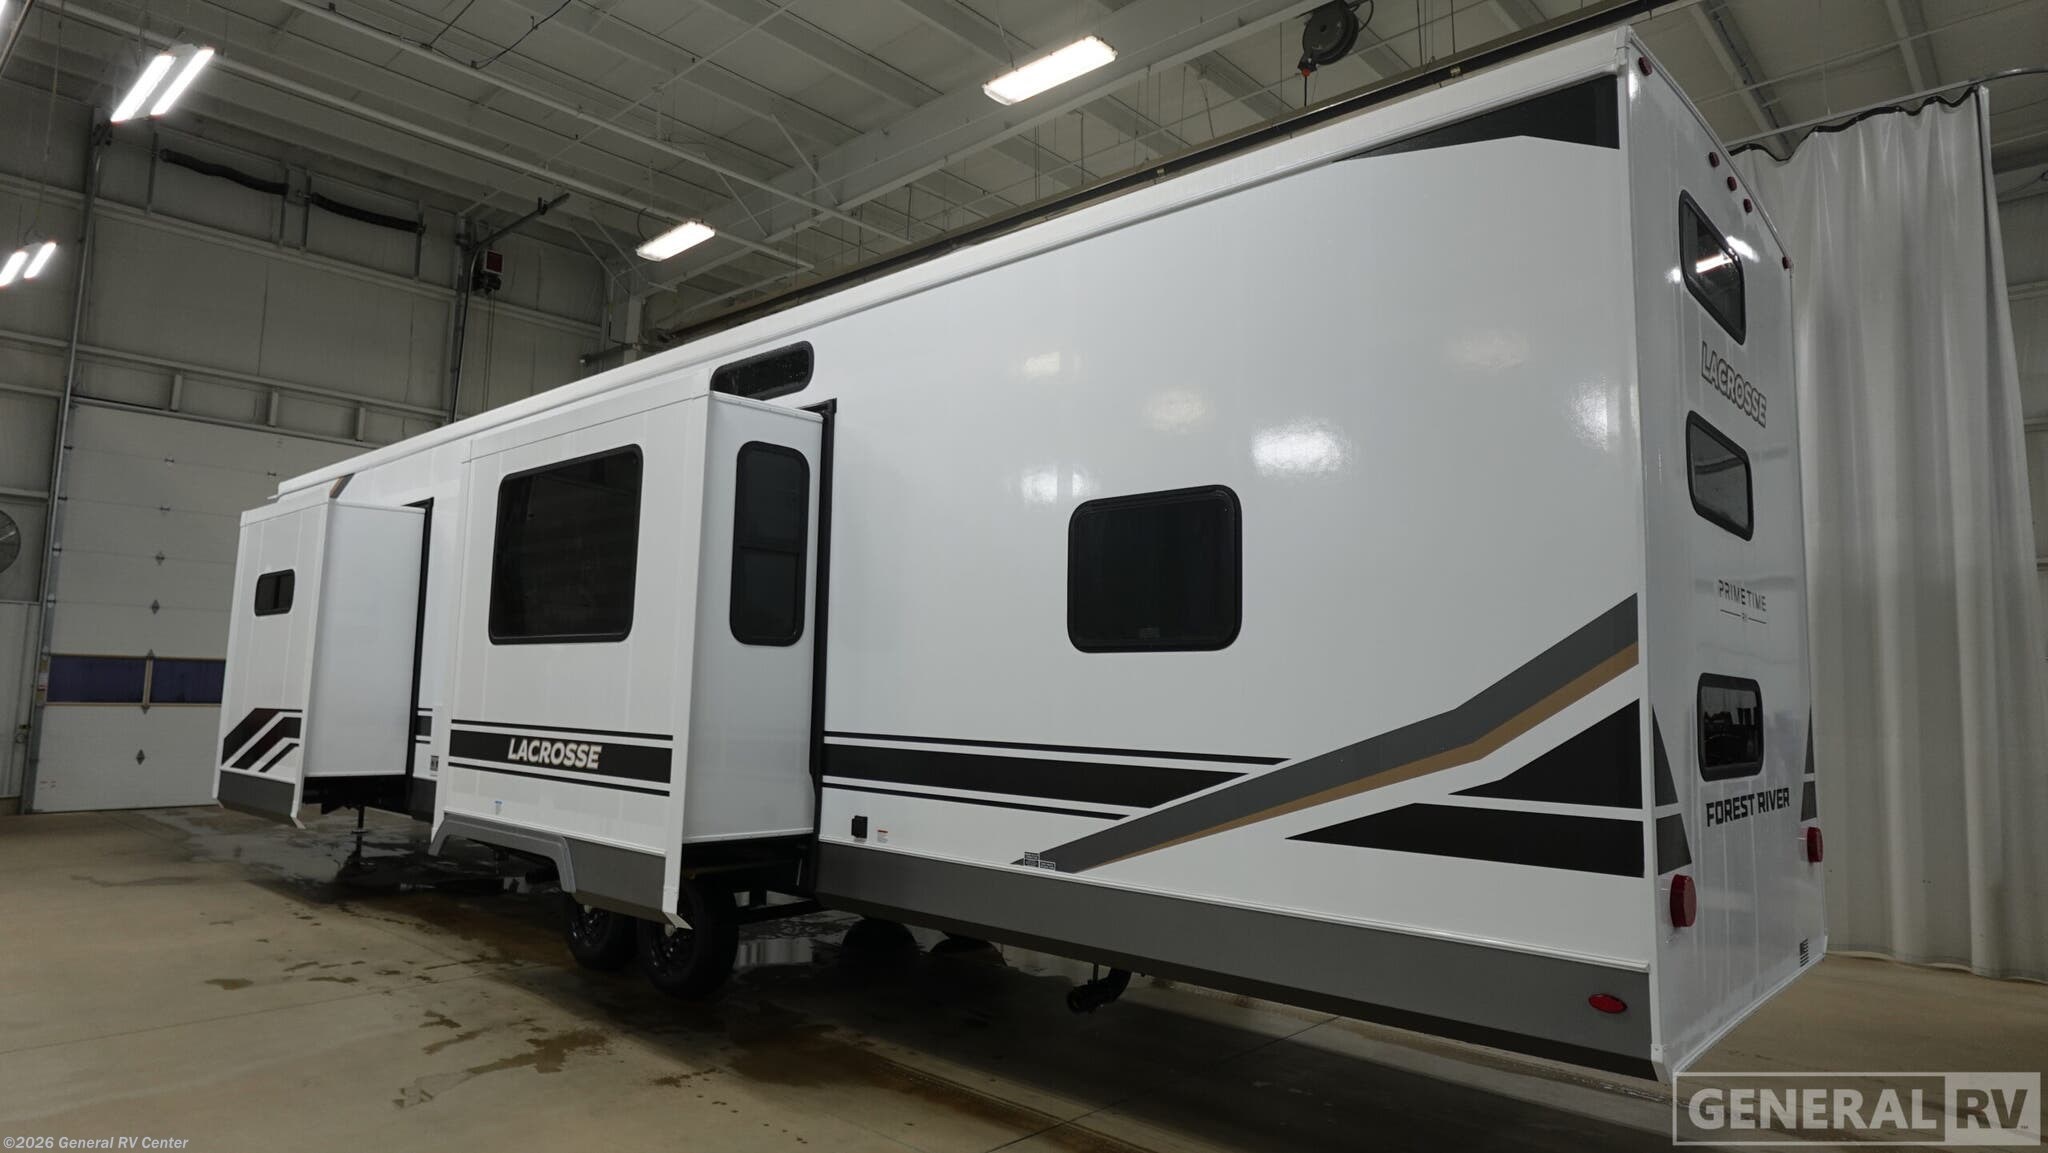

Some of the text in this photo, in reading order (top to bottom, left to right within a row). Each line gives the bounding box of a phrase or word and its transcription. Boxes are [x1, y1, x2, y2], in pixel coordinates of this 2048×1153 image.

[1702, 341, 1767, 428] LACROSSE
[507, 737, 602, 769] LACROSSE
[1706, 787, 1790, 827] FOREST RIVER
